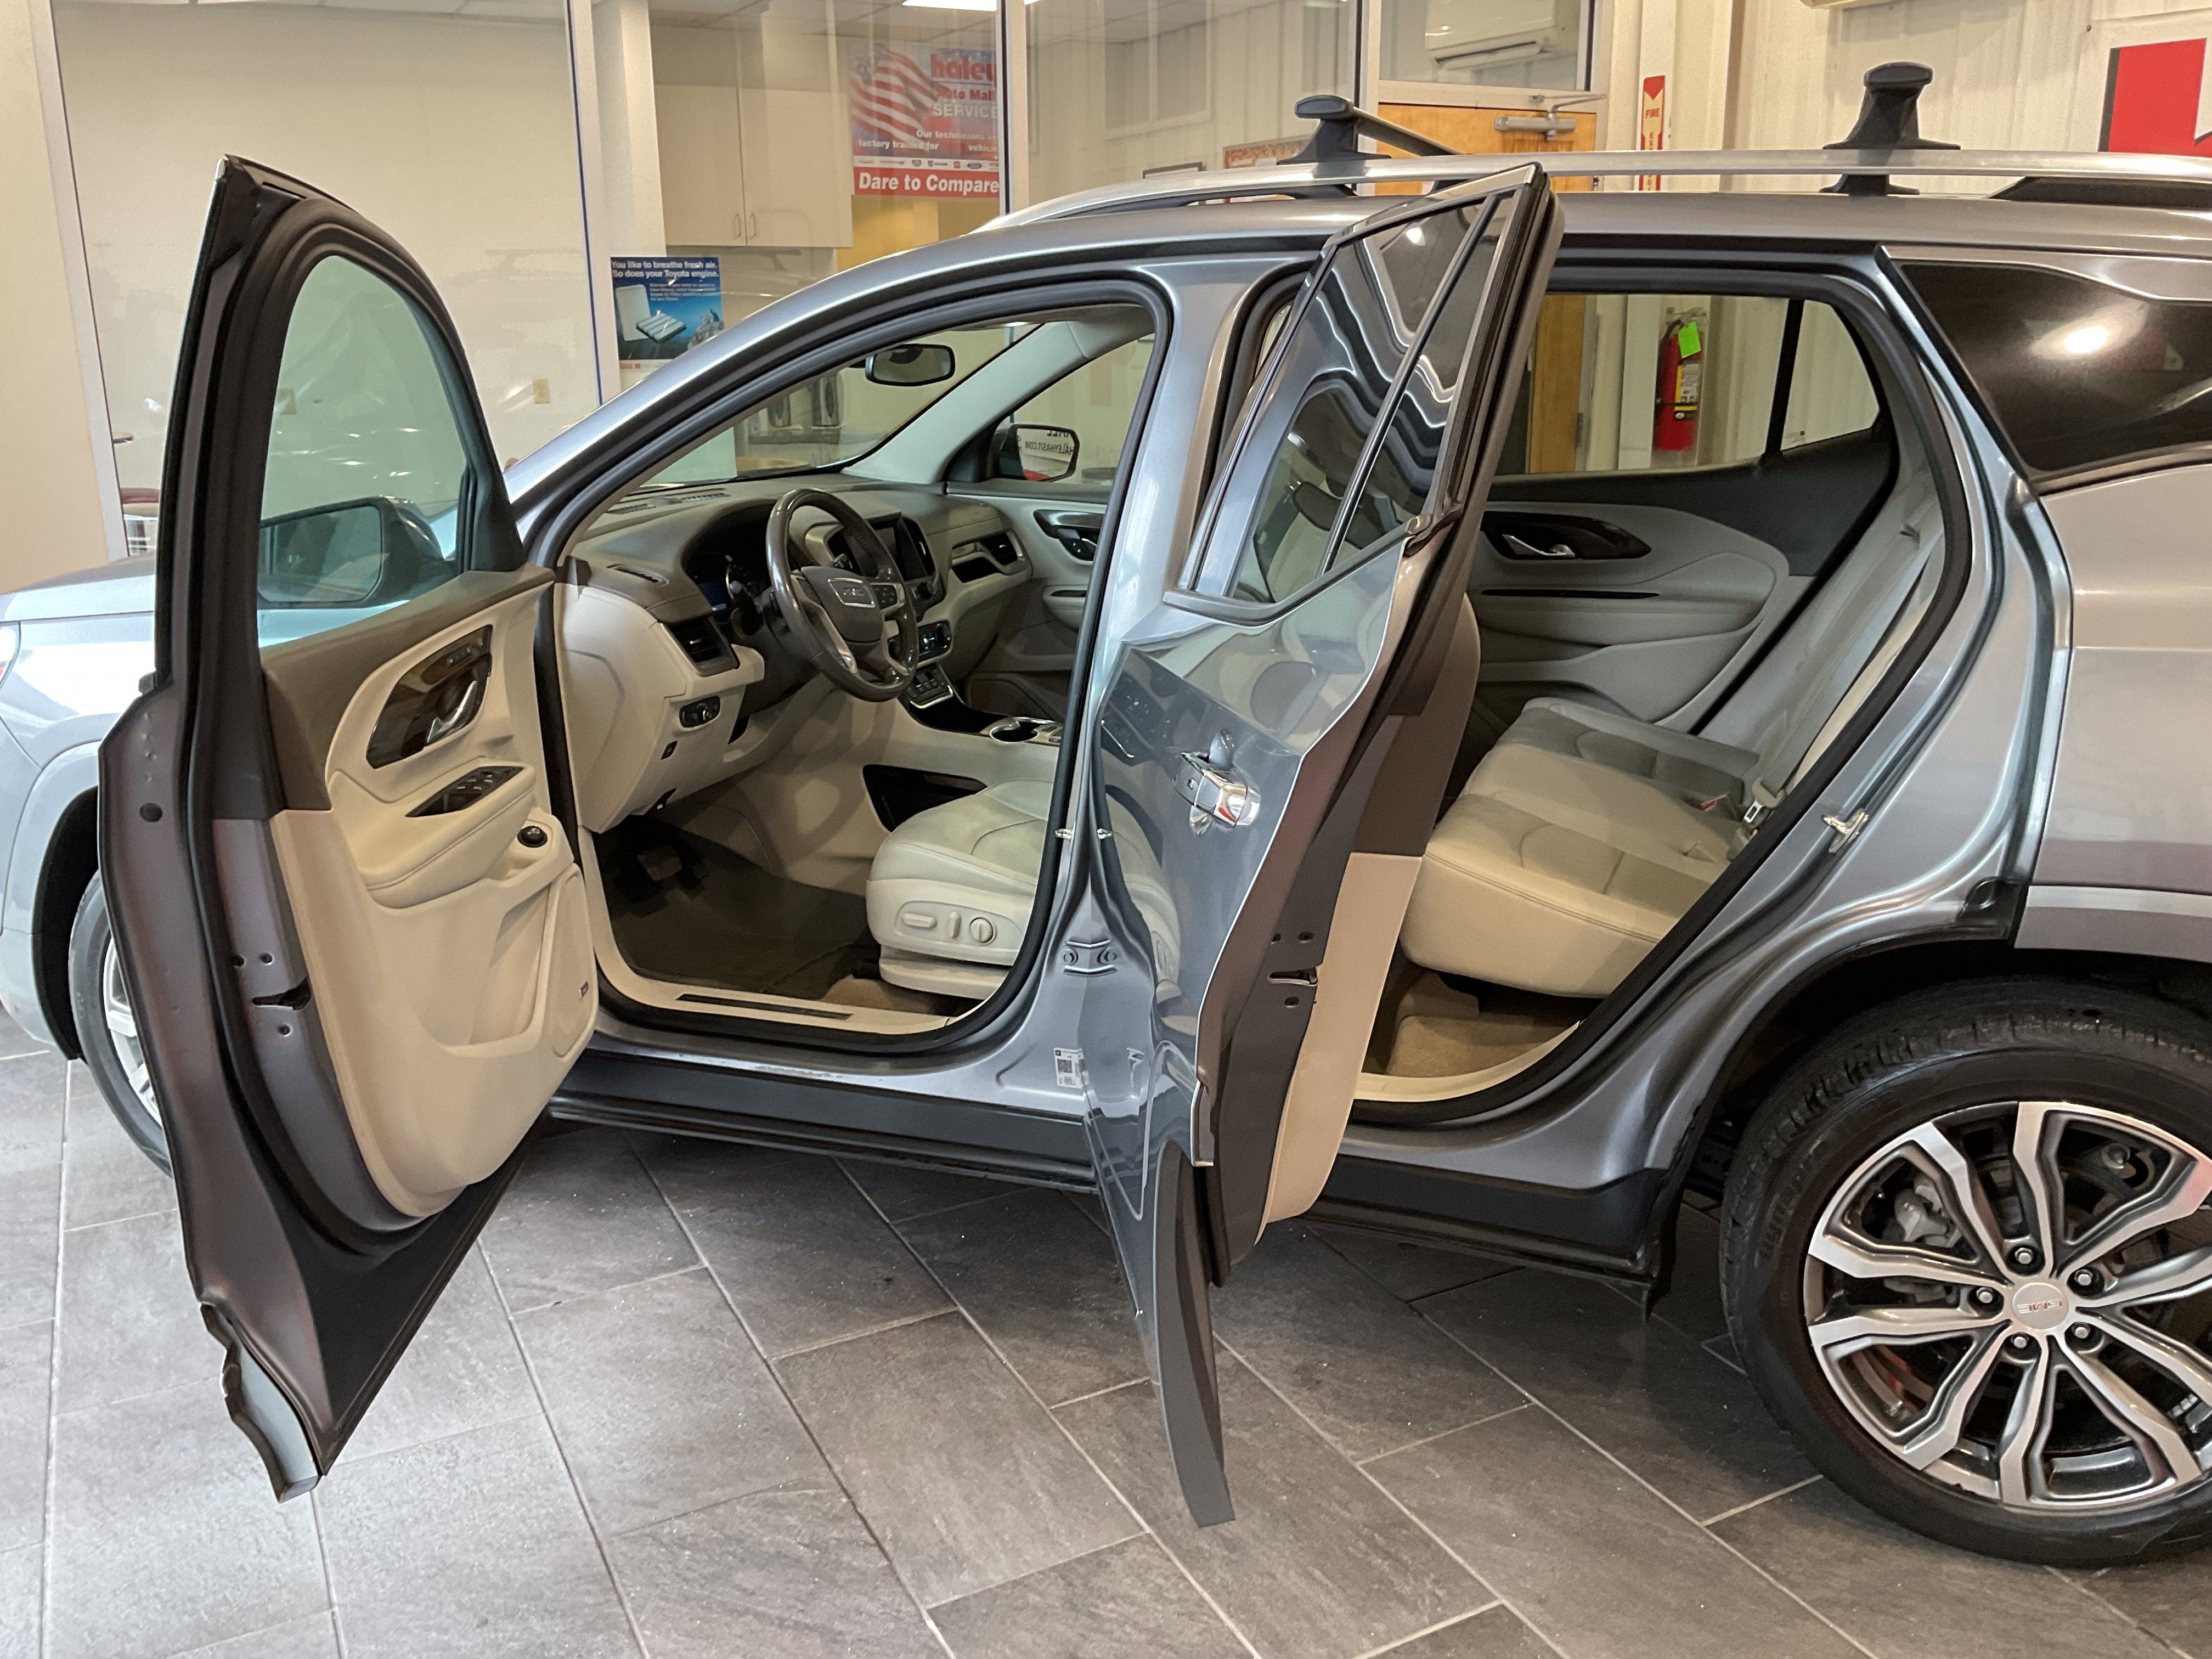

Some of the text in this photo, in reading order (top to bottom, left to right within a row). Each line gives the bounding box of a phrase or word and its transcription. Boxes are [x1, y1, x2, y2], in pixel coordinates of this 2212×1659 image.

[935, 131, 985, 140] technicians
[859, 139, 890, 149] factory
[893, 140, 924, 149] trained
[926, 142, 939, 151] for
[859, 172, 1000, 196] Dare to Compare
[627, 261, 642, 269] like
[644, 261, 652, 269] to
[653, 261, 683, 269] breathe
[612, 269, 624, 278] So
[645, 271, 663, 279] your
[664, 269, 690, 279] Toyota
[691, 270, 720, 279] engine.
[2017, 1299, 2063, 1314] GMC
